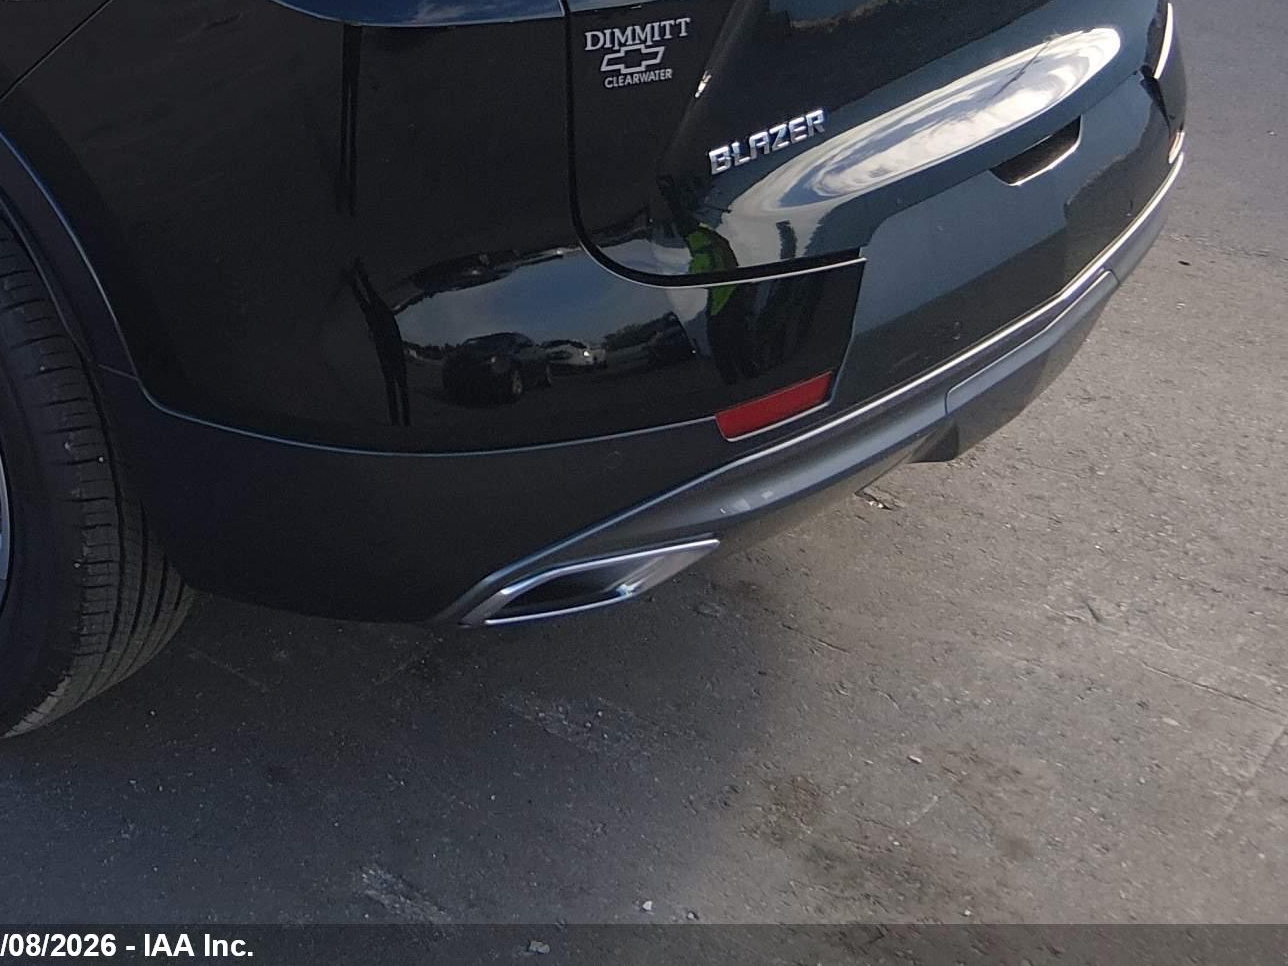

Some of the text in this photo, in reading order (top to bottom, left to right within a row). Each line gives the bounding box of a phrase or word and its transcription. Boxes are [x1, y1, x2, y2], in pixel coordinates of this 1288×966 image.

[584, 17, 691, 51] DIMMITT
[604, 68, 673, 89] CLEARWATER
[709, 109, 825, 176] BLAZER
